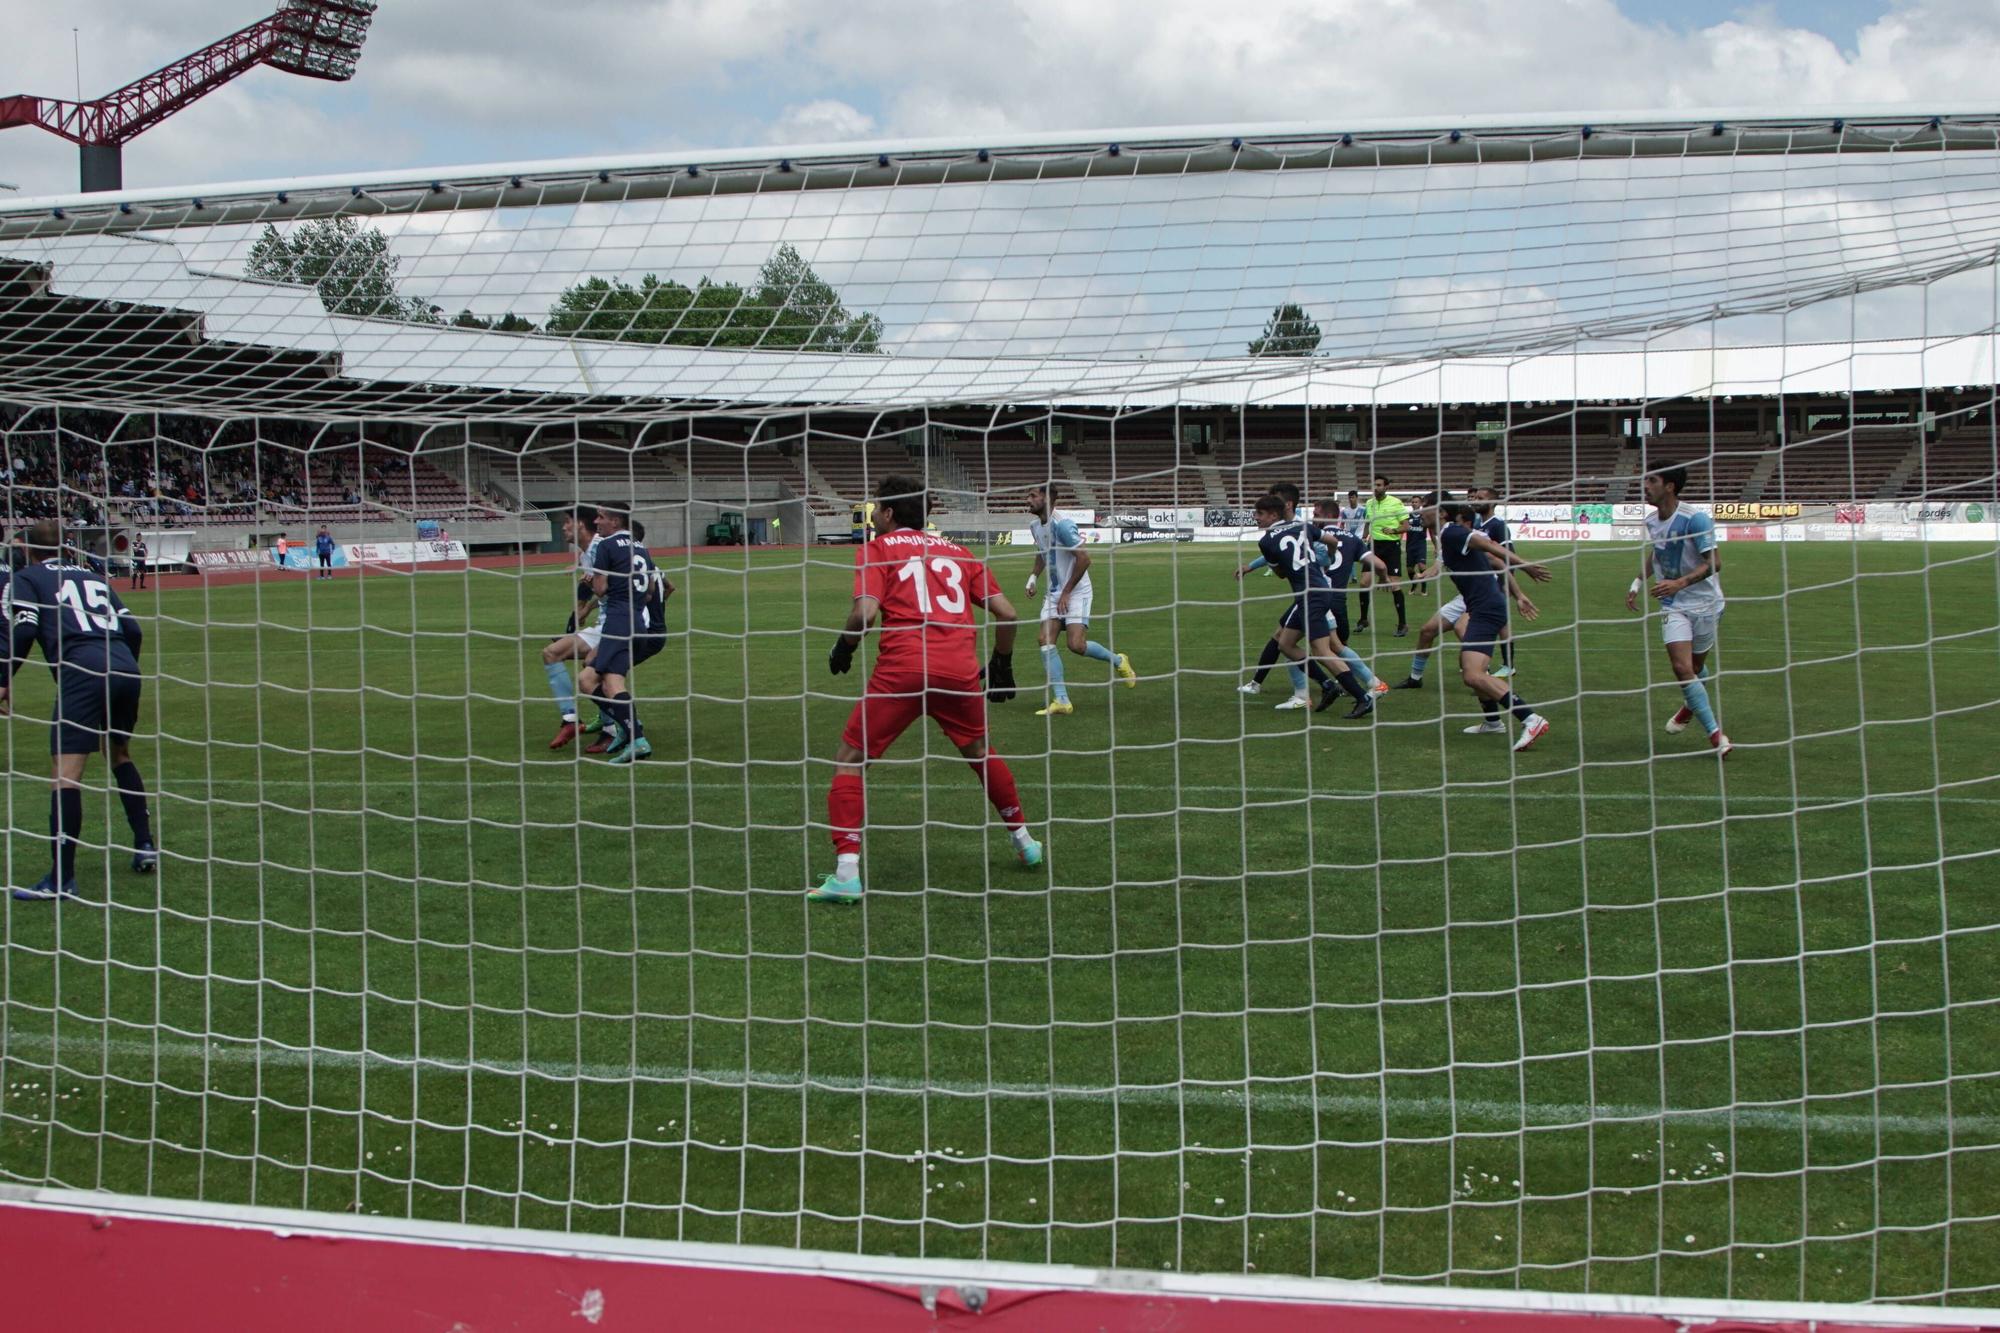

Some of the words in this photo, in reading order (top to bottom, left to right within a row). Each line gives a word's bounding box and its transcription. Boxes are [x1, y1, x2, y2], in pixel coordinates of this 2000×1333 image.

[1714, 503, 1756, 515] BOEL
[633, 554, 650, 593] 3
[898, 555, 966, 614] 13
[55, 579, 119, 632] 15
